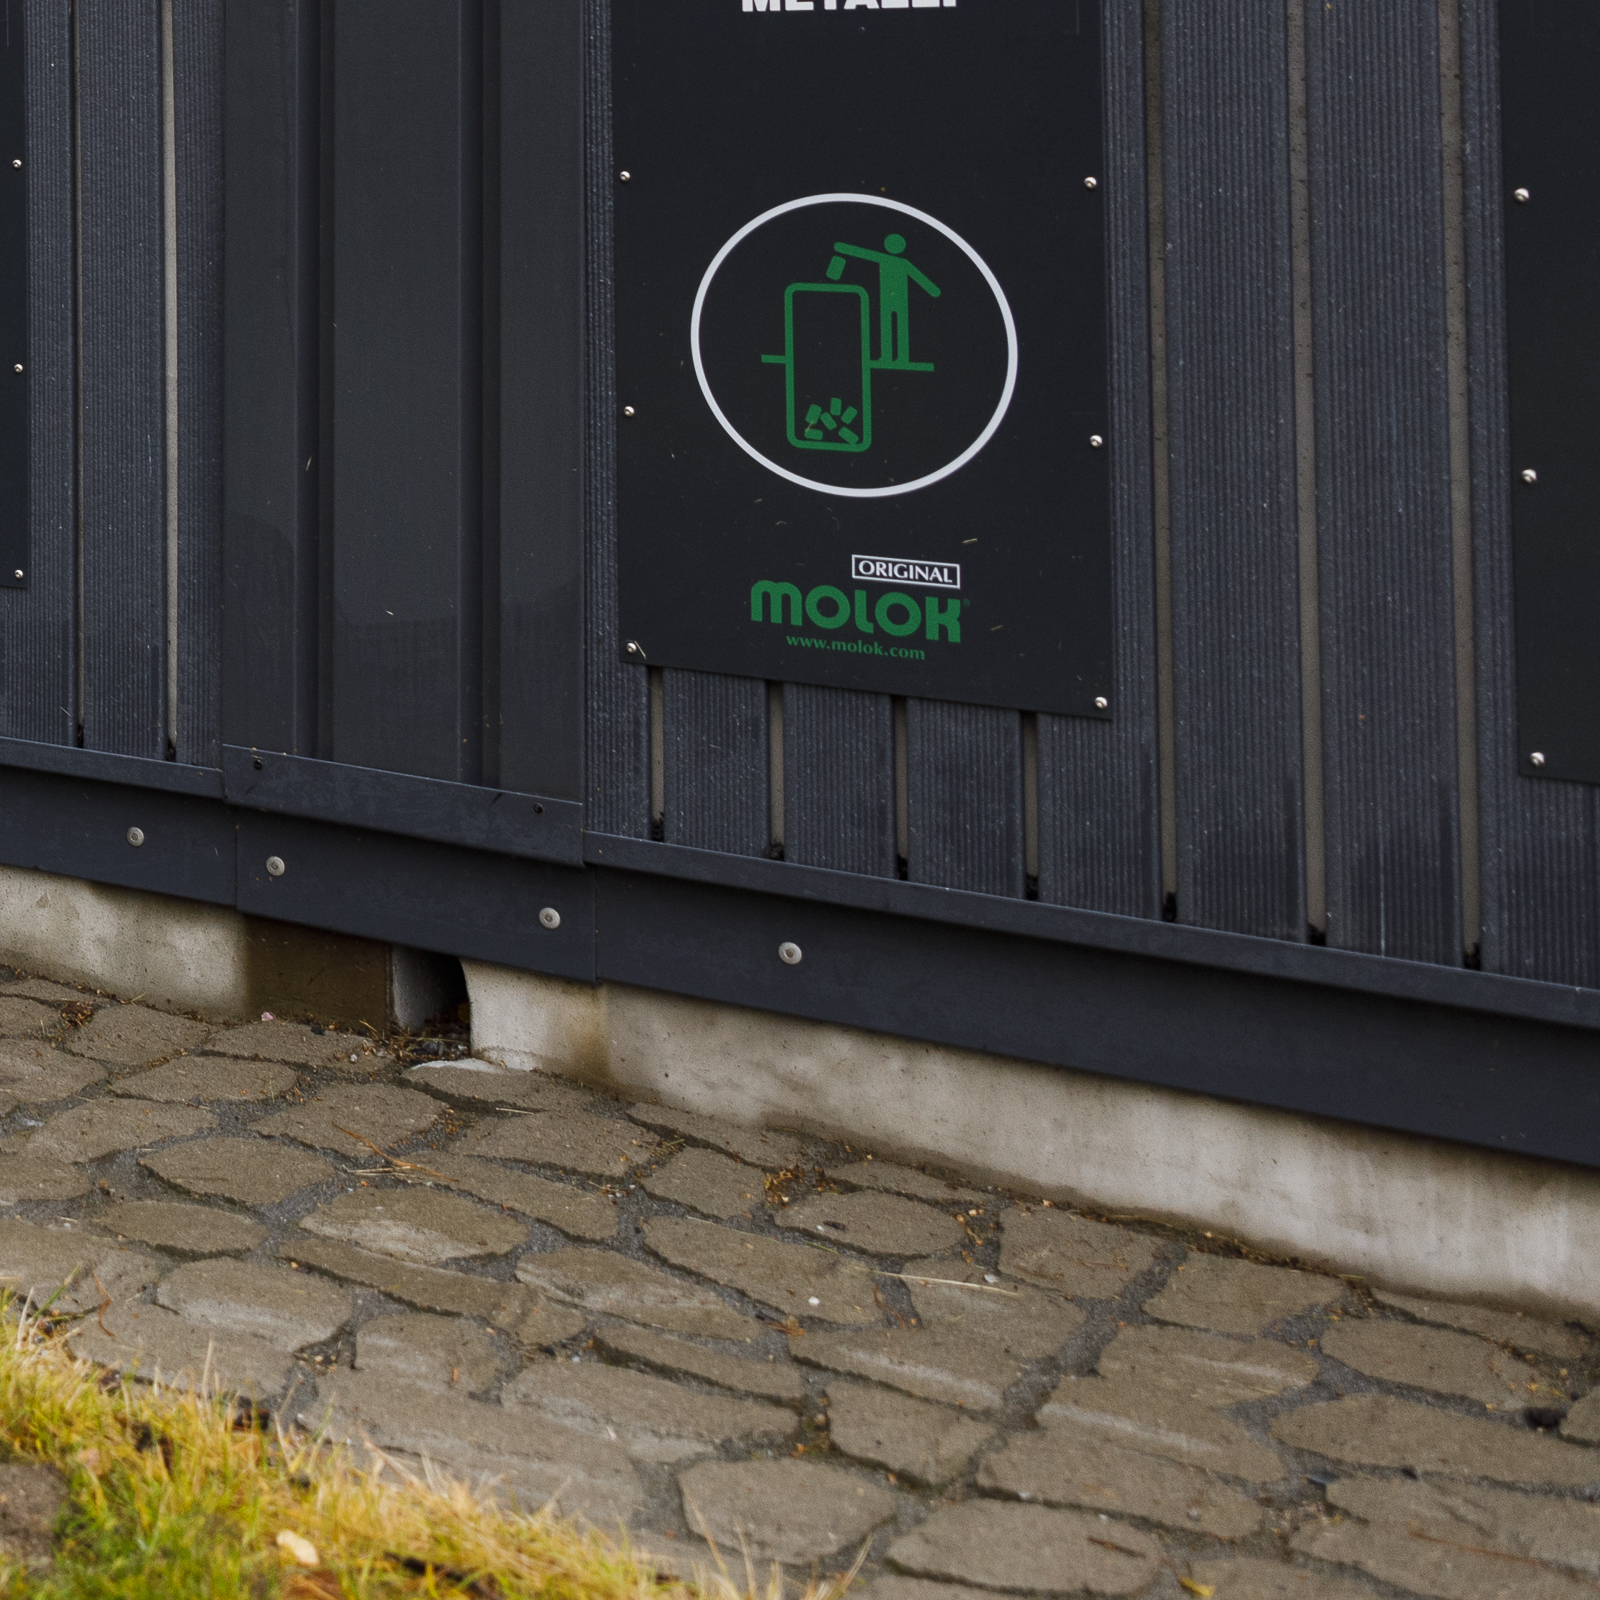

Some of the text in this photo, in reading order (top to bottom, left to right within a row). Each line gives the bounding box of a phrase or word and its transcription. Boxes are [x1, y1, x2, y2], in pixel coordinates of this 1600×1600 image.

[858, 560, 953, 583] ORIGINAL
[751, 580, 961, 643] MOLOK
[786, 635, 926, 660] www.molok.com
